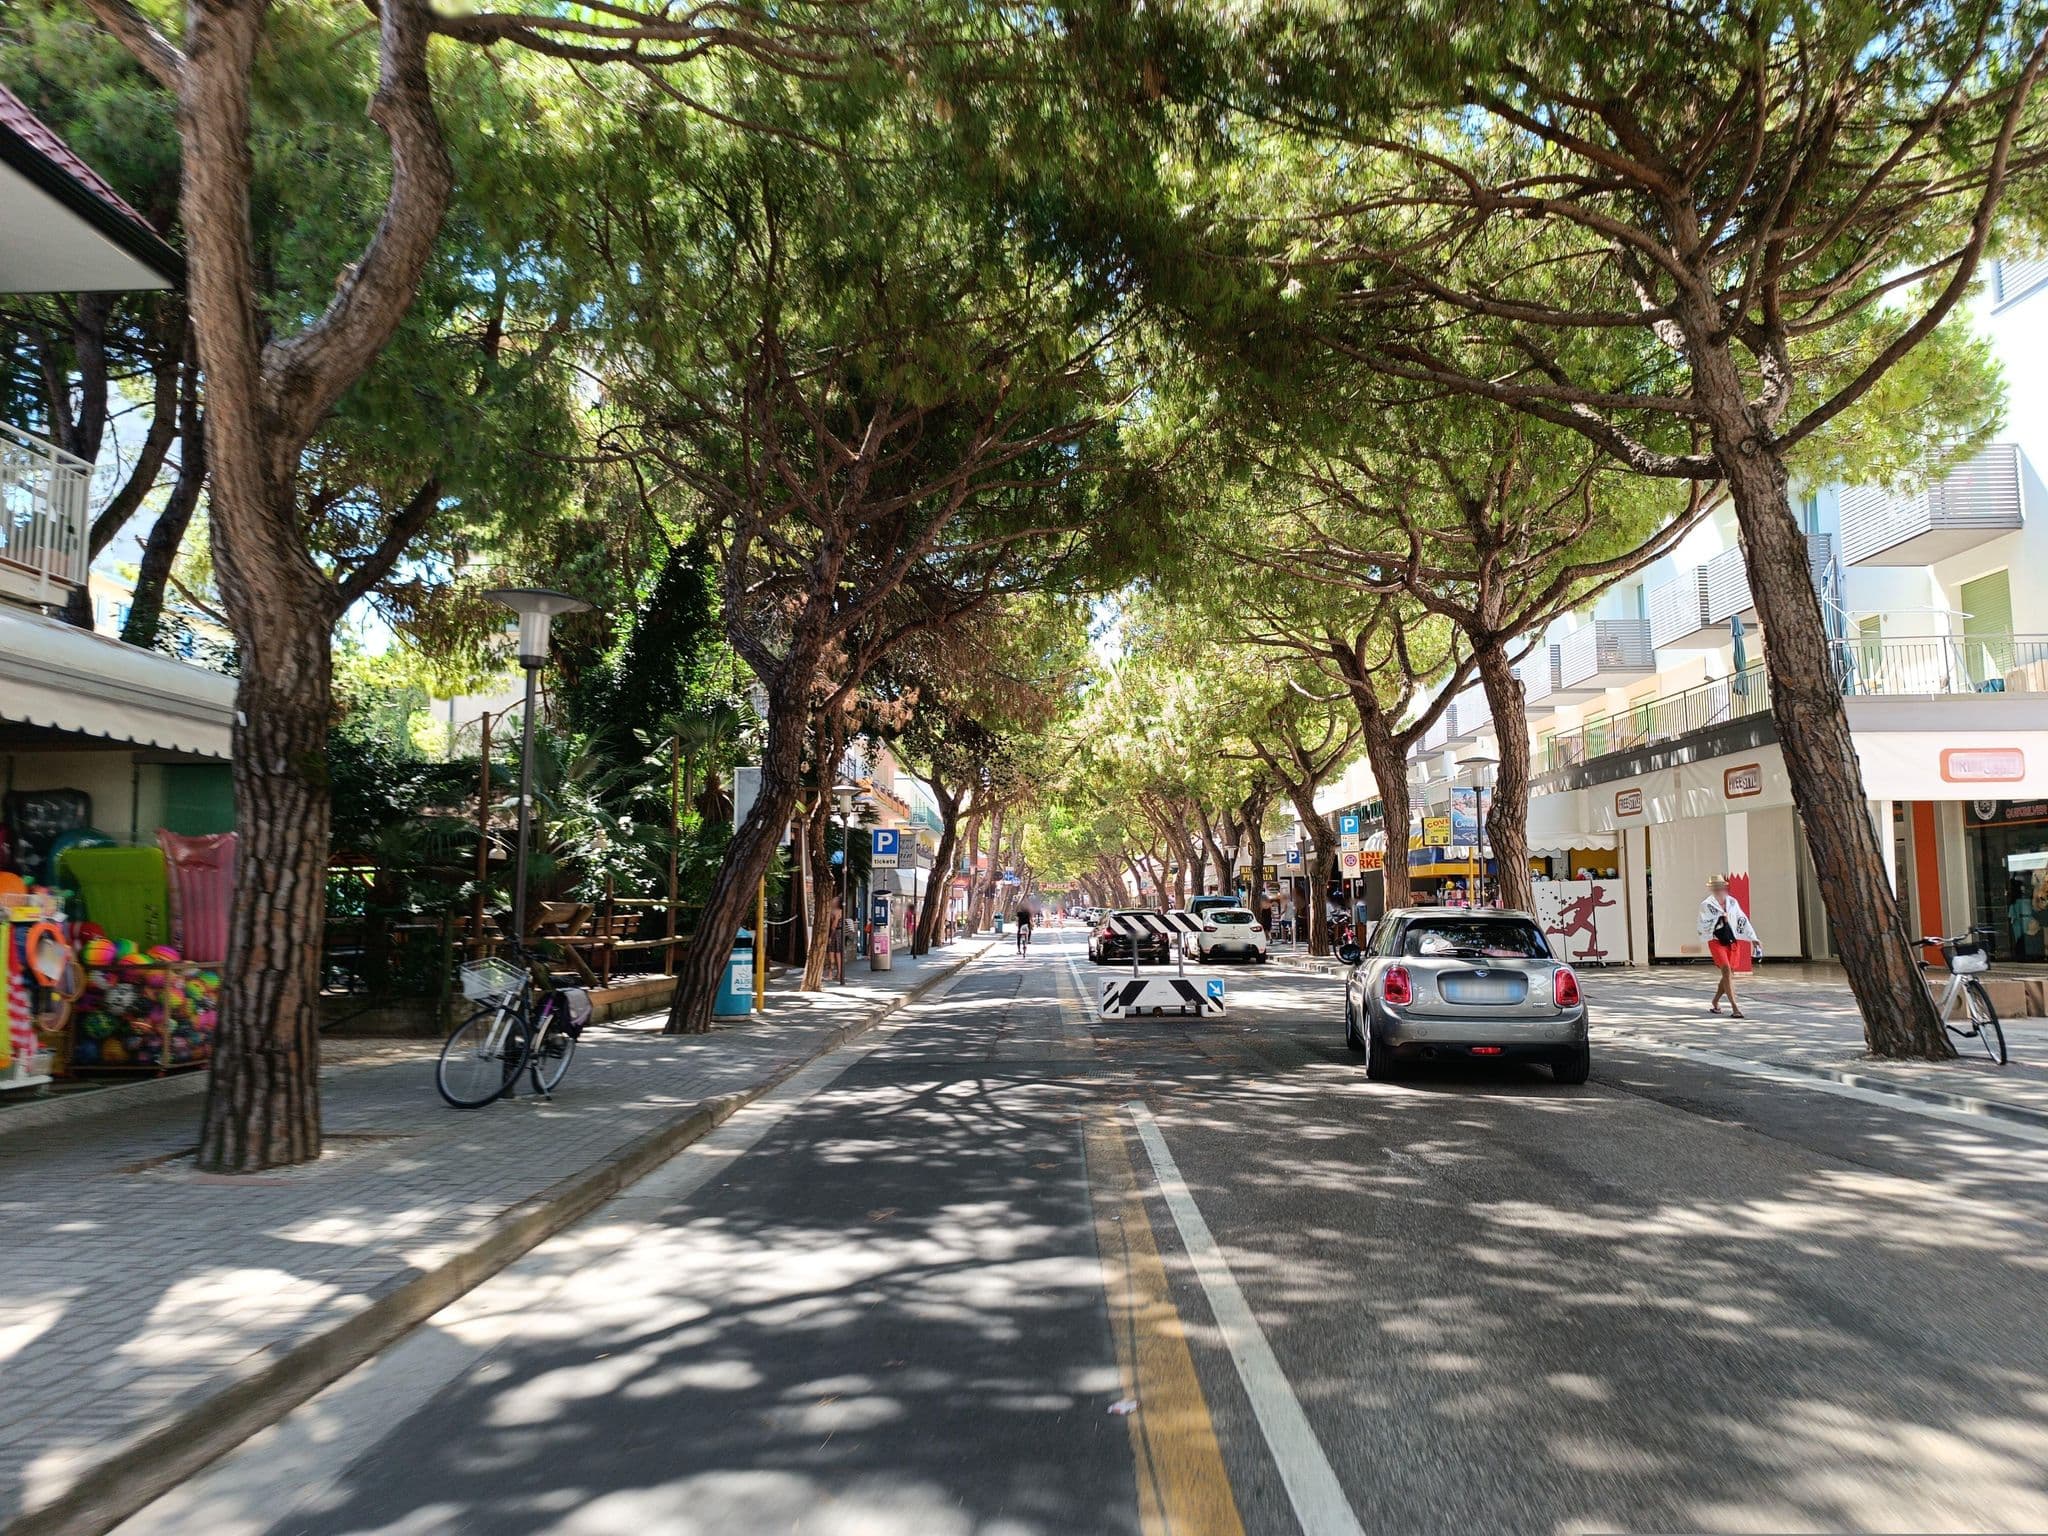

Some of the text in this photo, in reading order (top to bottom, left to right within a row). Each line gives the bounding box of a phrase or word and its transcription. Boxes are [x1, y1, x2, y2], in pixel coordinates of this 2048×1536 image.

[1344, 819, 1355, 832] P
[878, 832, 893, 852] P
[1289, 852, 1297, 862] P
